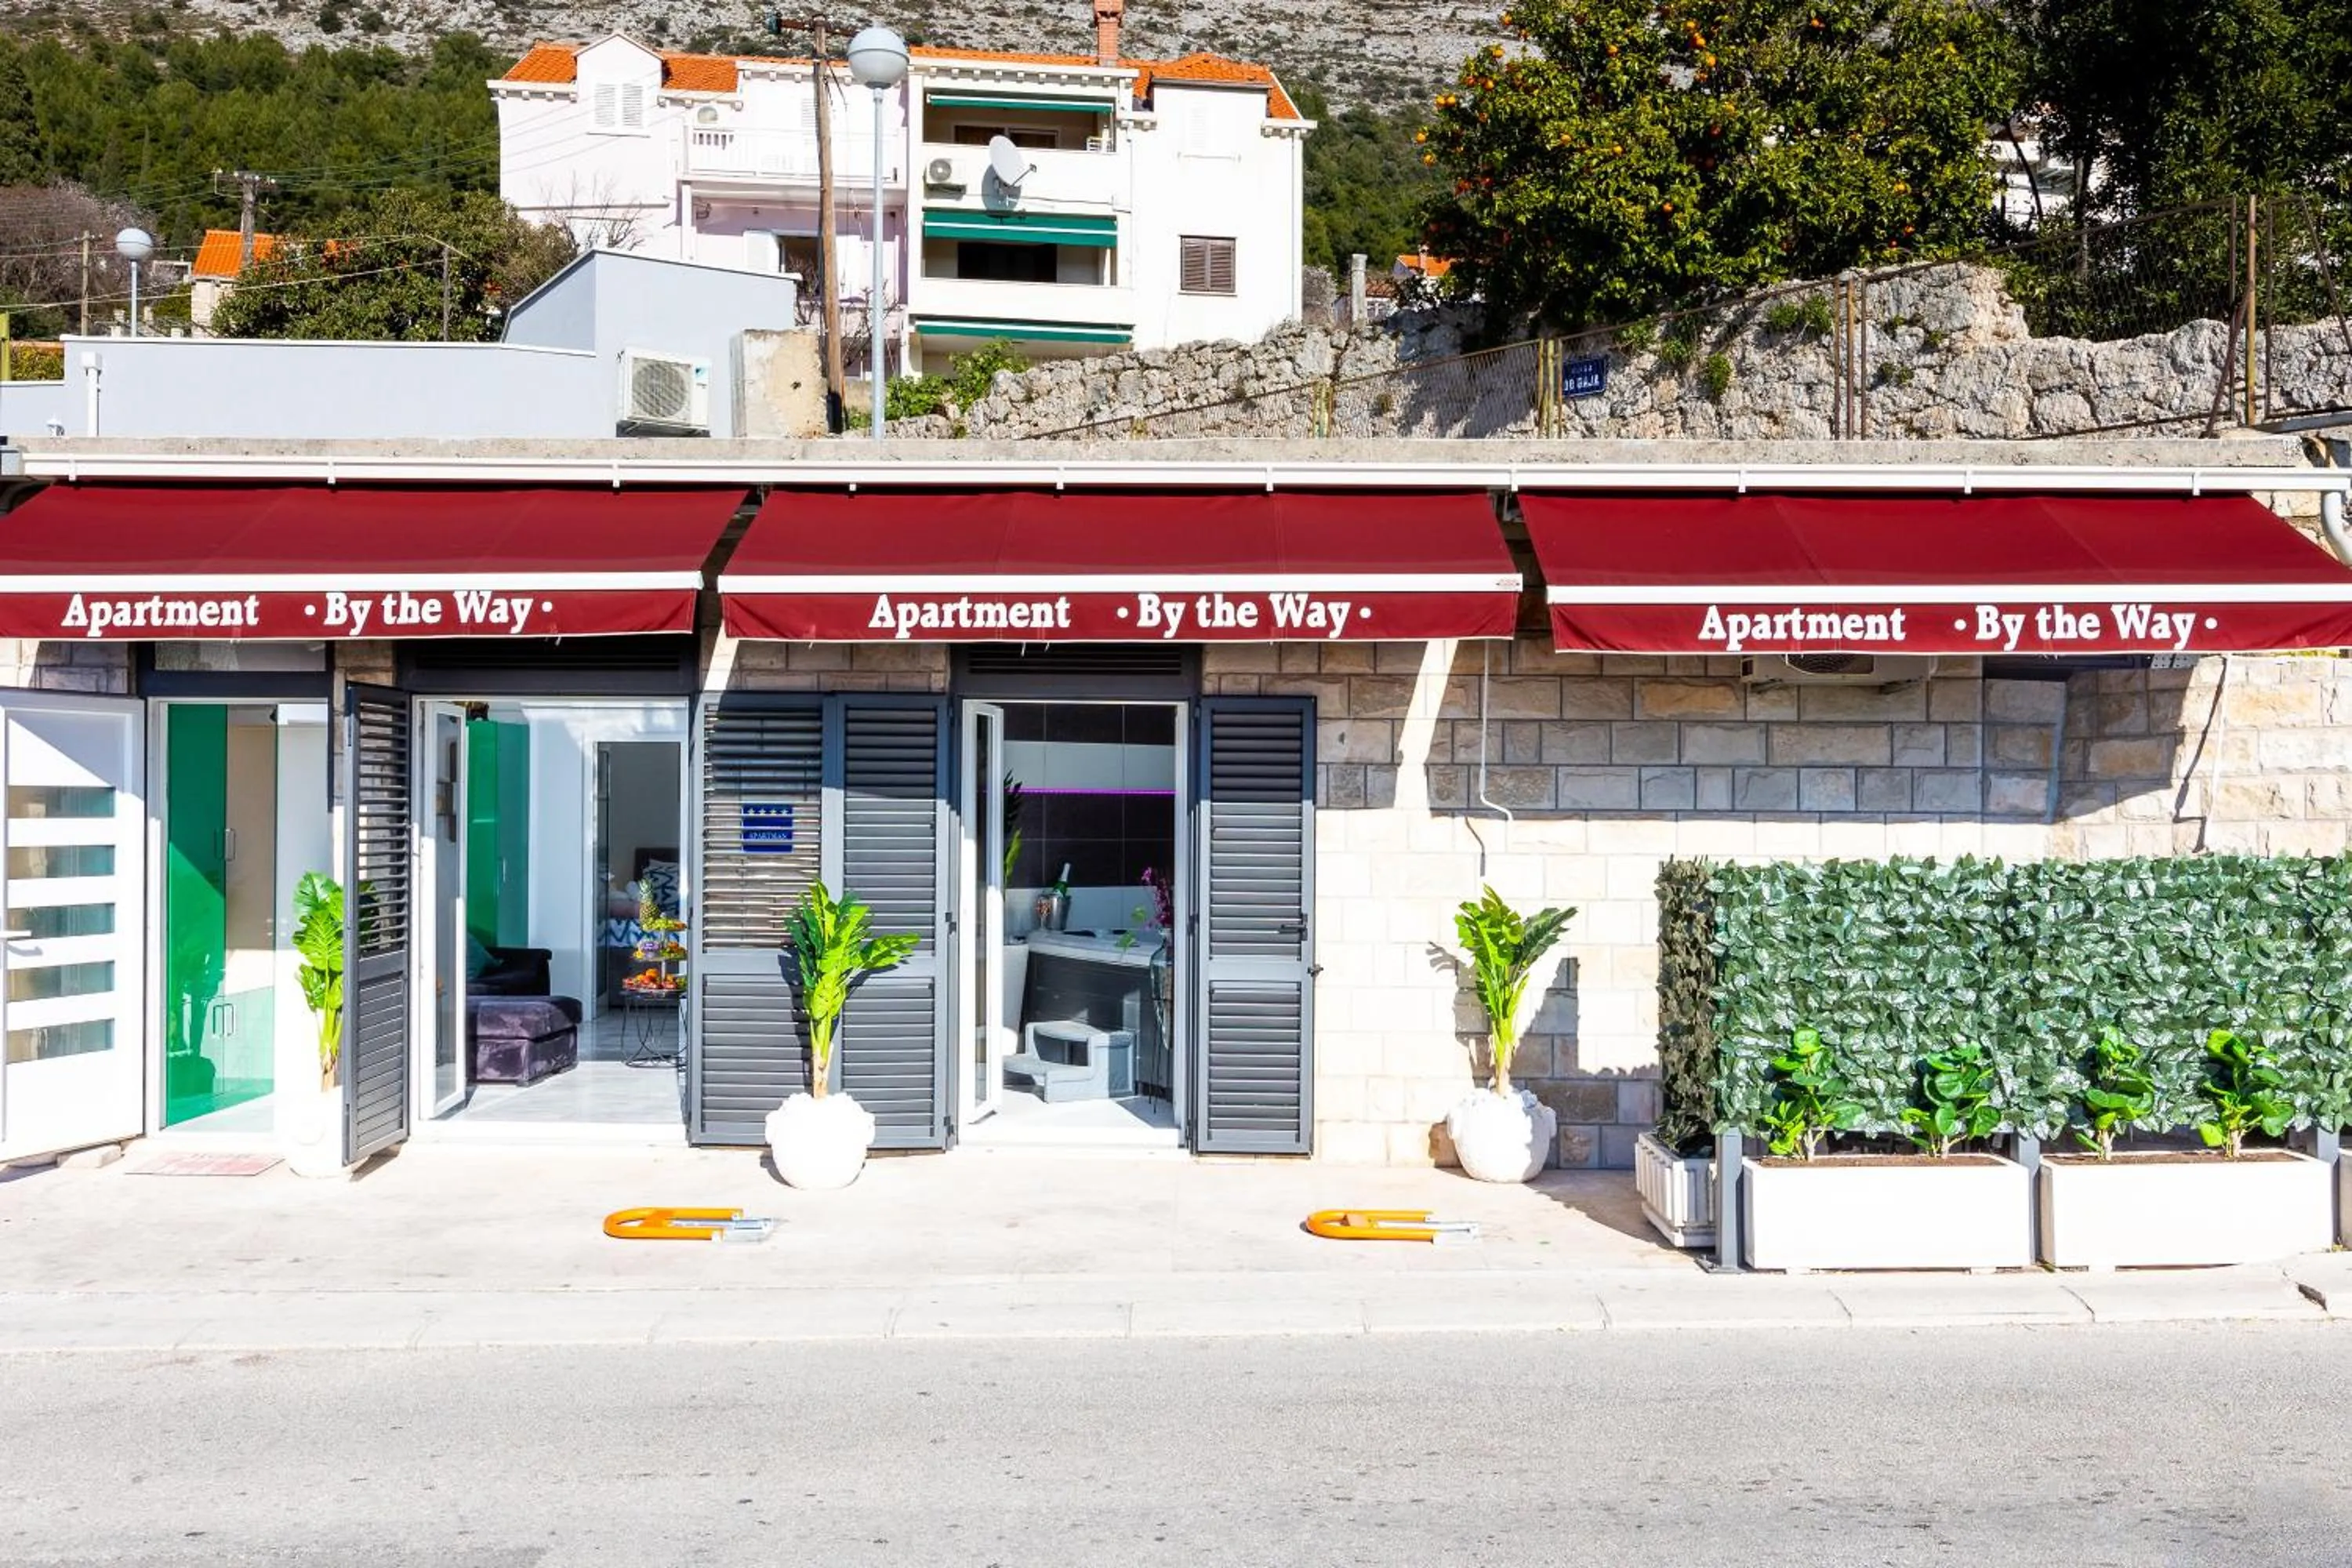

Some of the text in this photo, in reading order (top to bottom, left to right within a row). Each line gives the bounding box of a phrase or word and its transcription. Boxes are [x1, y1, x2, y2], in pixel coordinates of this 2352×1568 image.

[60, 590, 534, 637] Apartment By the Way
[868, 592, 1351, 640] Apartment By the Way
[1697, 603, 2195, 652] Apartment By the Way
